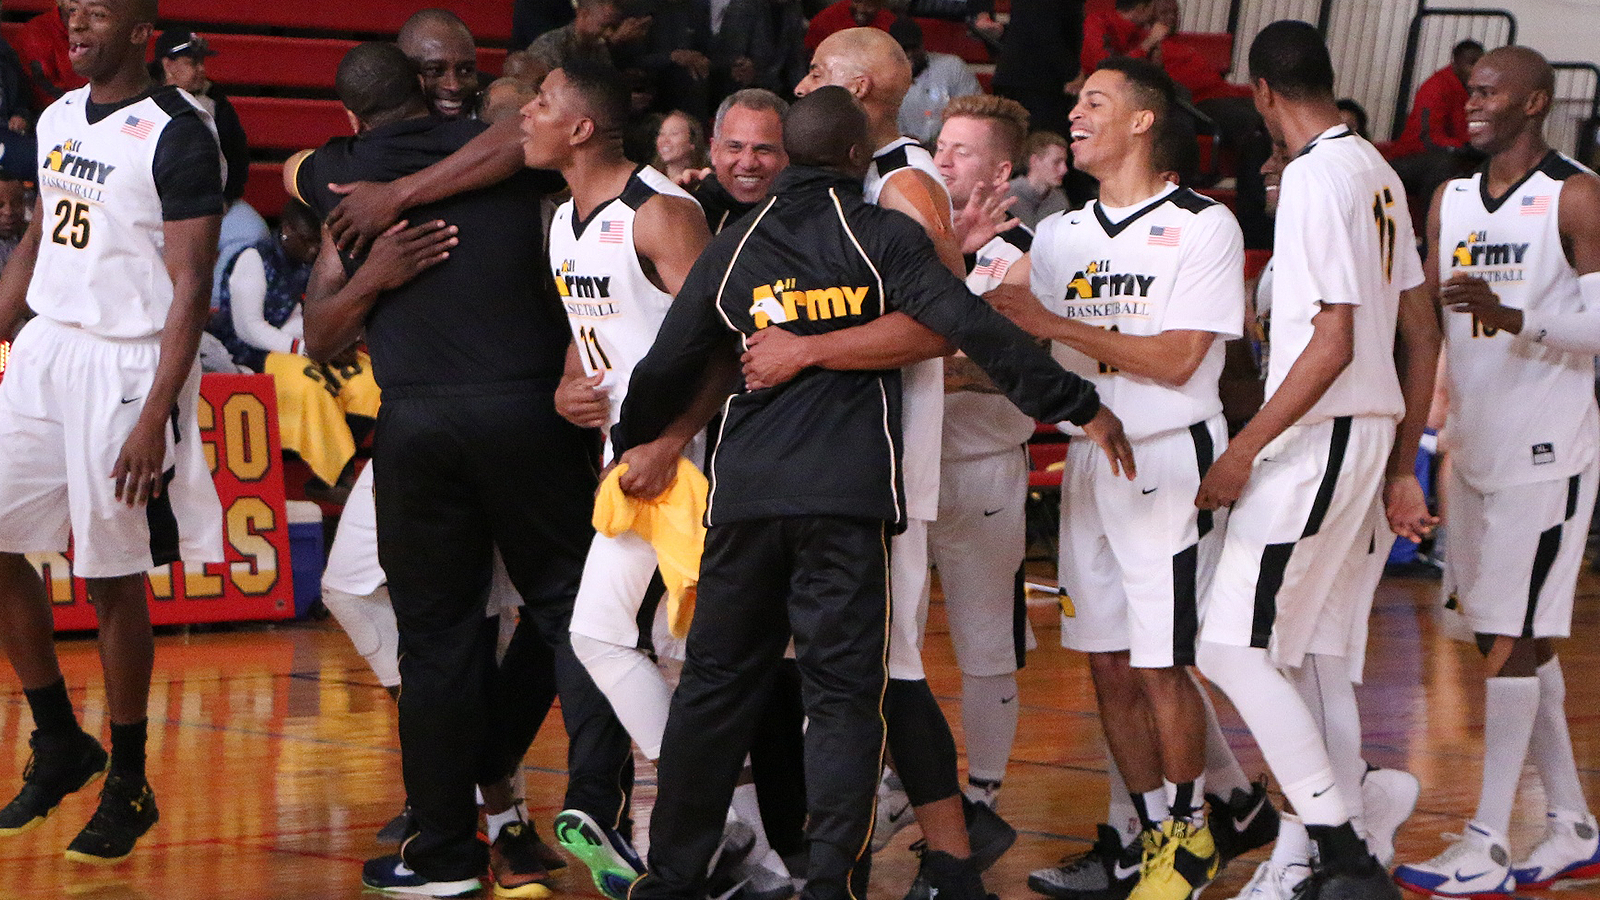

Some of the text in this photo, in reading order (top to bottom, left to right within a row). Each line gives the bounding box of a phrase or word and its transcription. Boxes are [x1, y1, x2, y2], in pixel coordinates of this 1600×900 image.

[43, 143, 116, 185] Army
[41, 173, 105, 203] BASKETBALL
[52, 199, 91, 249] 25
[1452, 240, 1530, 267] Army
[1064, 270, 1157, 300] Army
[749, 284, 869, 329] Army
[1066, 302, 1150, 318] BASKETBALL
[580, 325, 612, 371] 11
